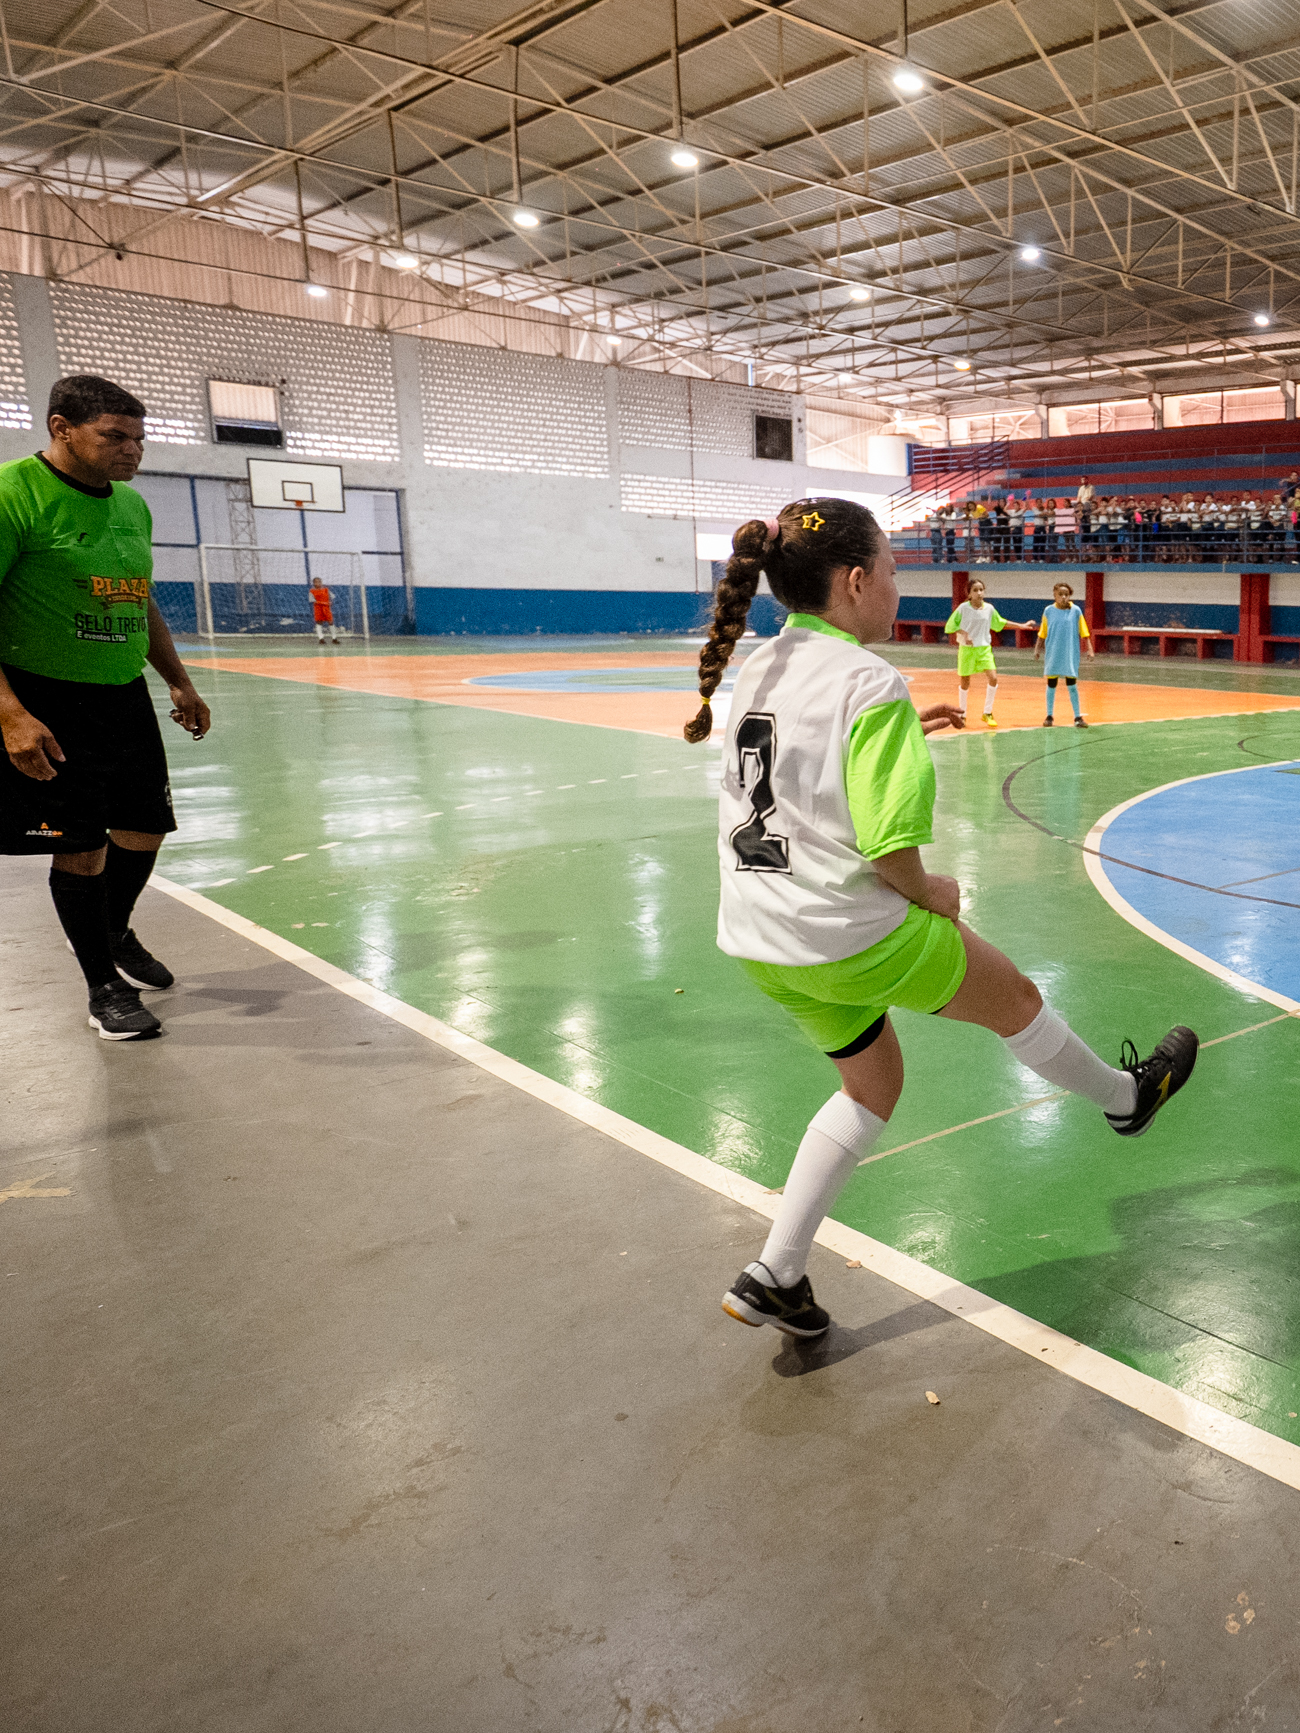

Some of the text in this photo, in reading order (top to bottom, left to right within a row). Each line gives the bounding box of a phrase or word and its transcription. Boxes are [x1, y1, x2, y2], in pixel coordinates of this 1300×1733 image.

[90, 575, 149, 598] PLAZA
[75, 613, 146, 633] GELO TREVO
[77, 630, 82, 638] E
[729, 711, 793, 875] 2
